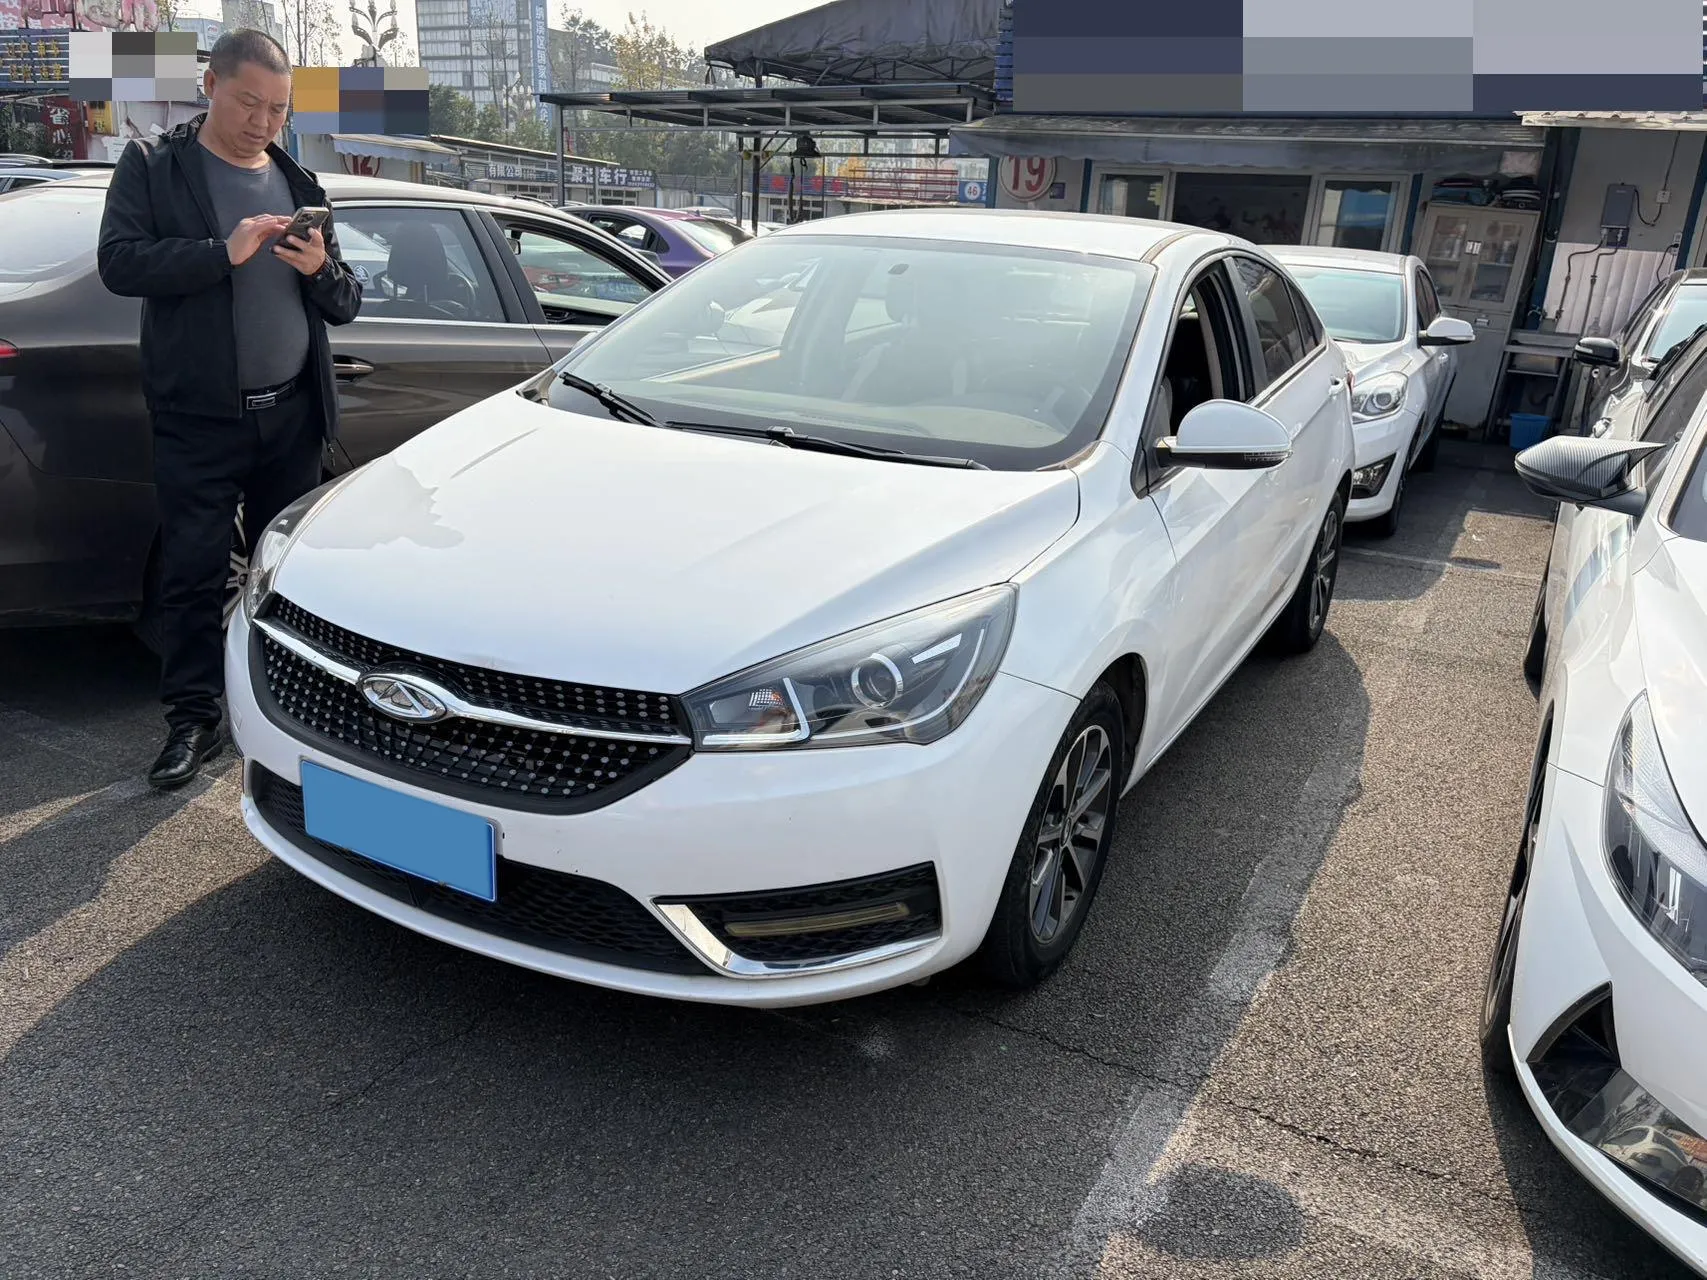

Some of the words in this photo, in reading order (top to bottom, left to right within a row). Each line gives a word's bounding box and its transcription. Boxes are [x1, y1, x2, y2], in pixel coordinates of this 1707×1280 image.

[488, 163, 523, 179] 有限公司
[1008, 155, 1046, 192] 19
[966, 185, 978, 197] 46
